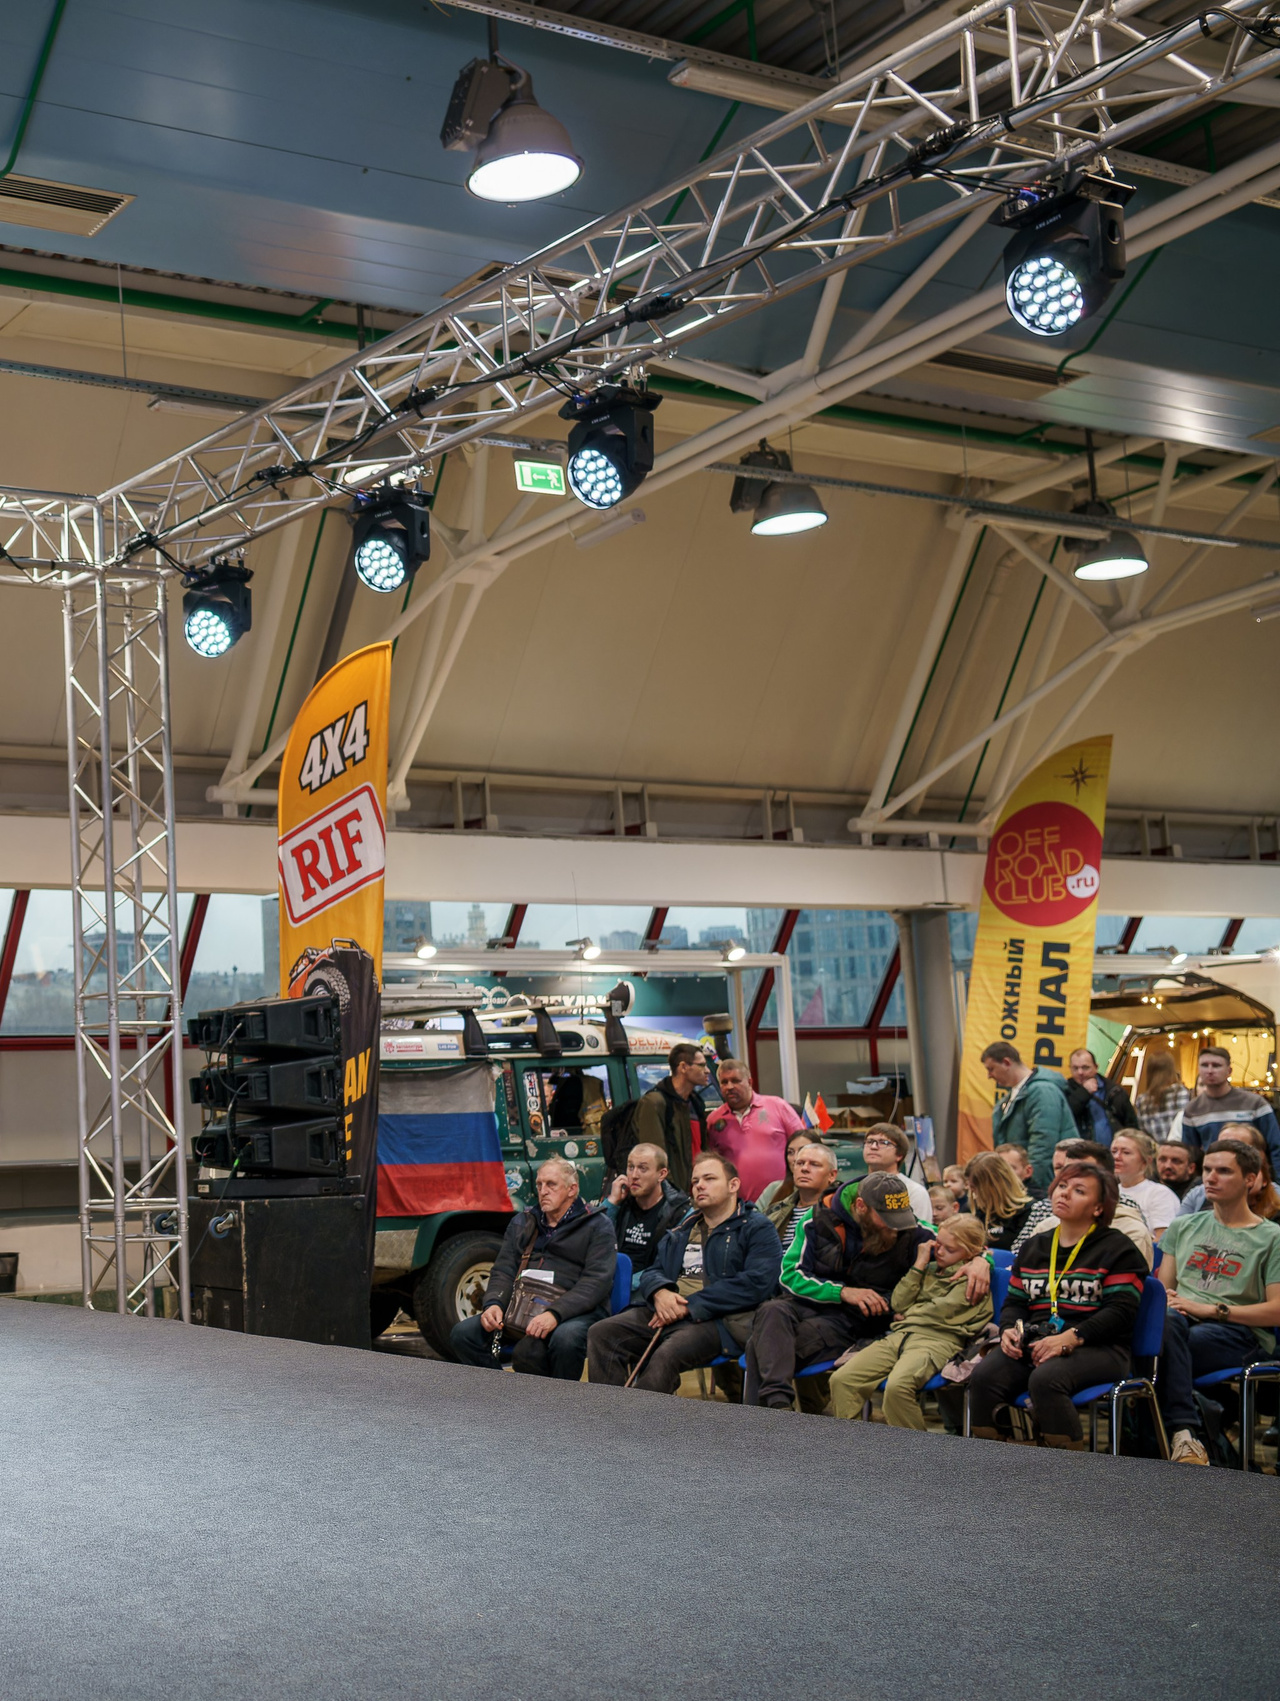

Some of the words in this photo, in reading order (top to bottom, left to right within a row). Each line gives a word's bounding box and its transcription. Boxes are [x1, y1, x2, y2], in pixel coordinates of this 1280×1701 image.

[298, 700, 370, 796] 4X4
[290, 807, 363, 902] RIF
[994, 848, 1085, 883] ROAD
[996, 826, 1061, 858] OFF
[994, 874, 1067, 905] CLUB
[1000, 938, 1025, 1040] ОЖНЫЙ
[1033, 941, 1071, 1068] РНАЛ
[343, 1047, 371, 1108] AN
